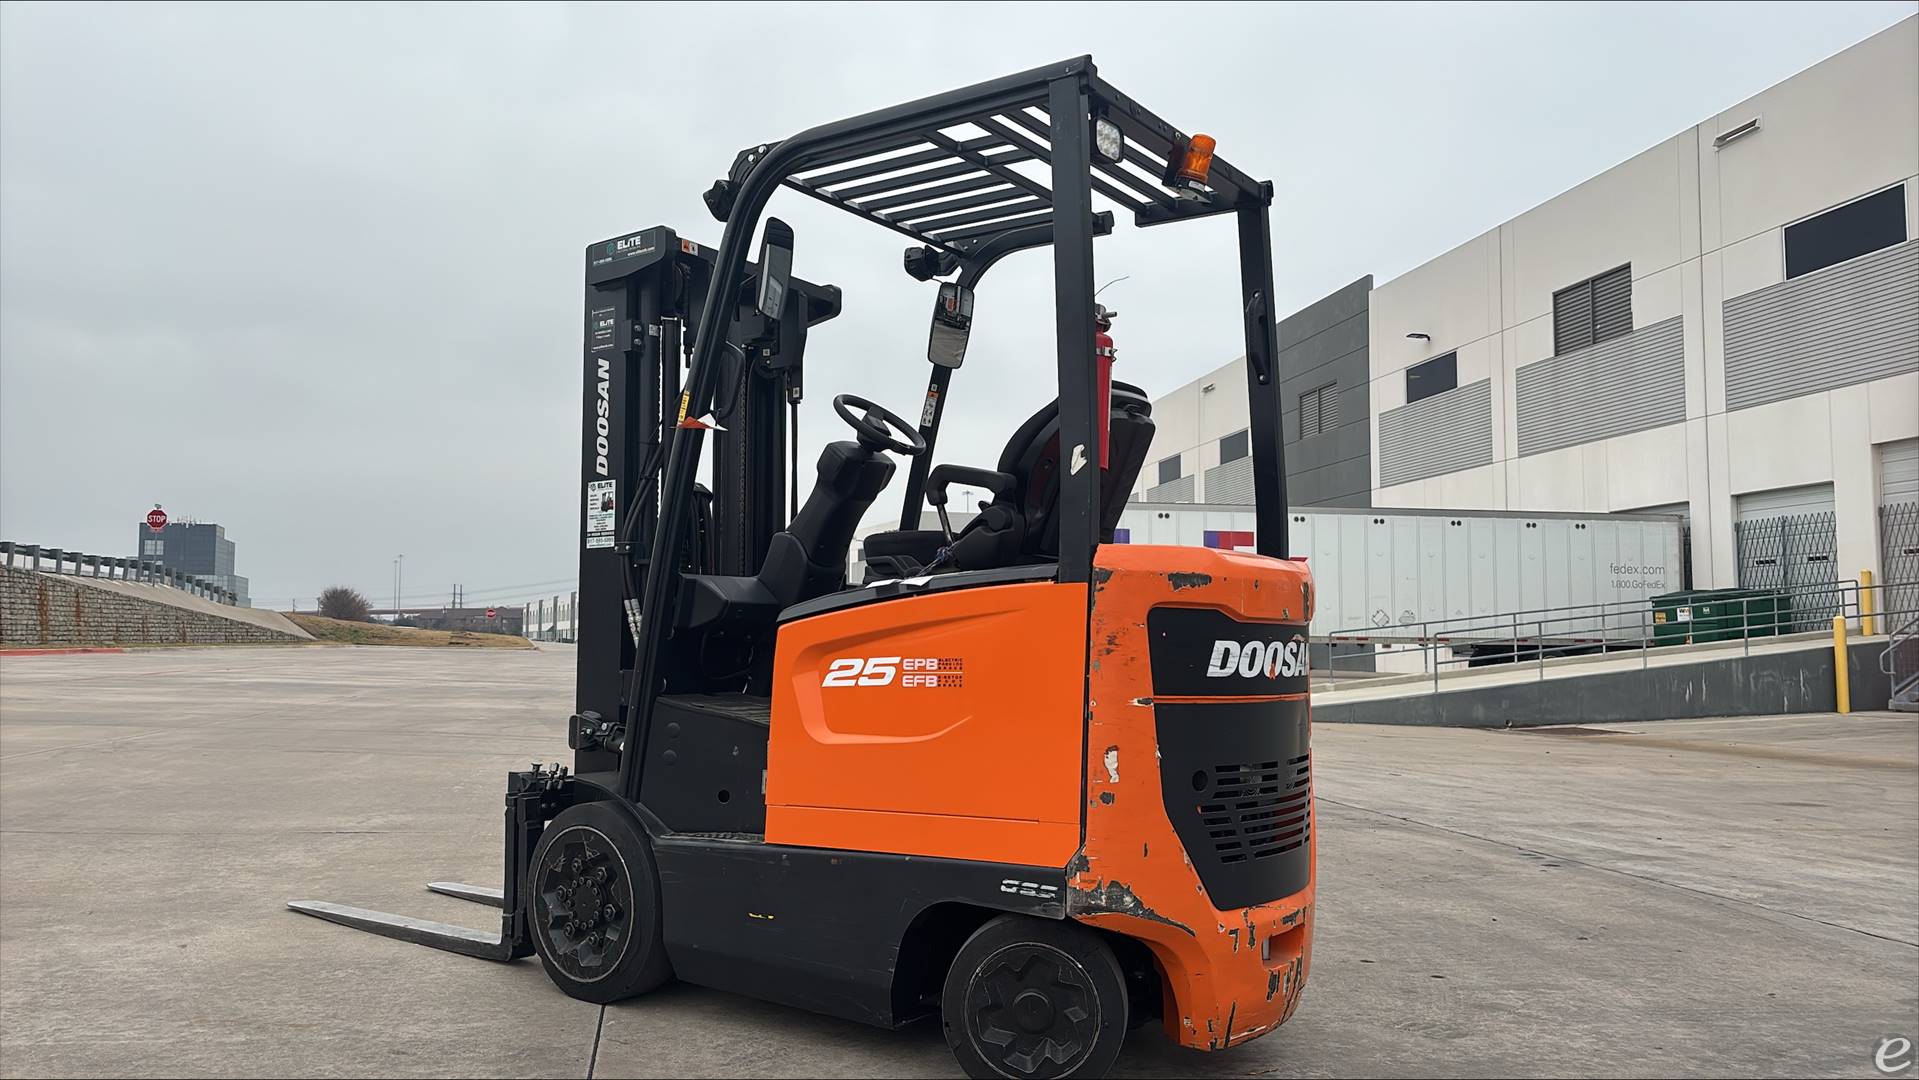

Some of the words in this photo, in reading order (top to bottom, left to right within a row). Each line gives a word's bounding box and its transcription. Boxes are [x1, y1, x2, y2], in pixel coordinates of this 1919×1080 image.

[617, 236, 641, 249] ELITE
[596, 358, 610, 476] DOOSAN
[148, 515, 166, 523] STOP
[1610, 563, 1665, 575] fedex.com
[1611, 580, 1665, 589] 1.800.GoFedEx
[821, 656, 901, 687] 25
[902, 658, 938, 670] EPB
[902, 675, 938, 687] EFB
